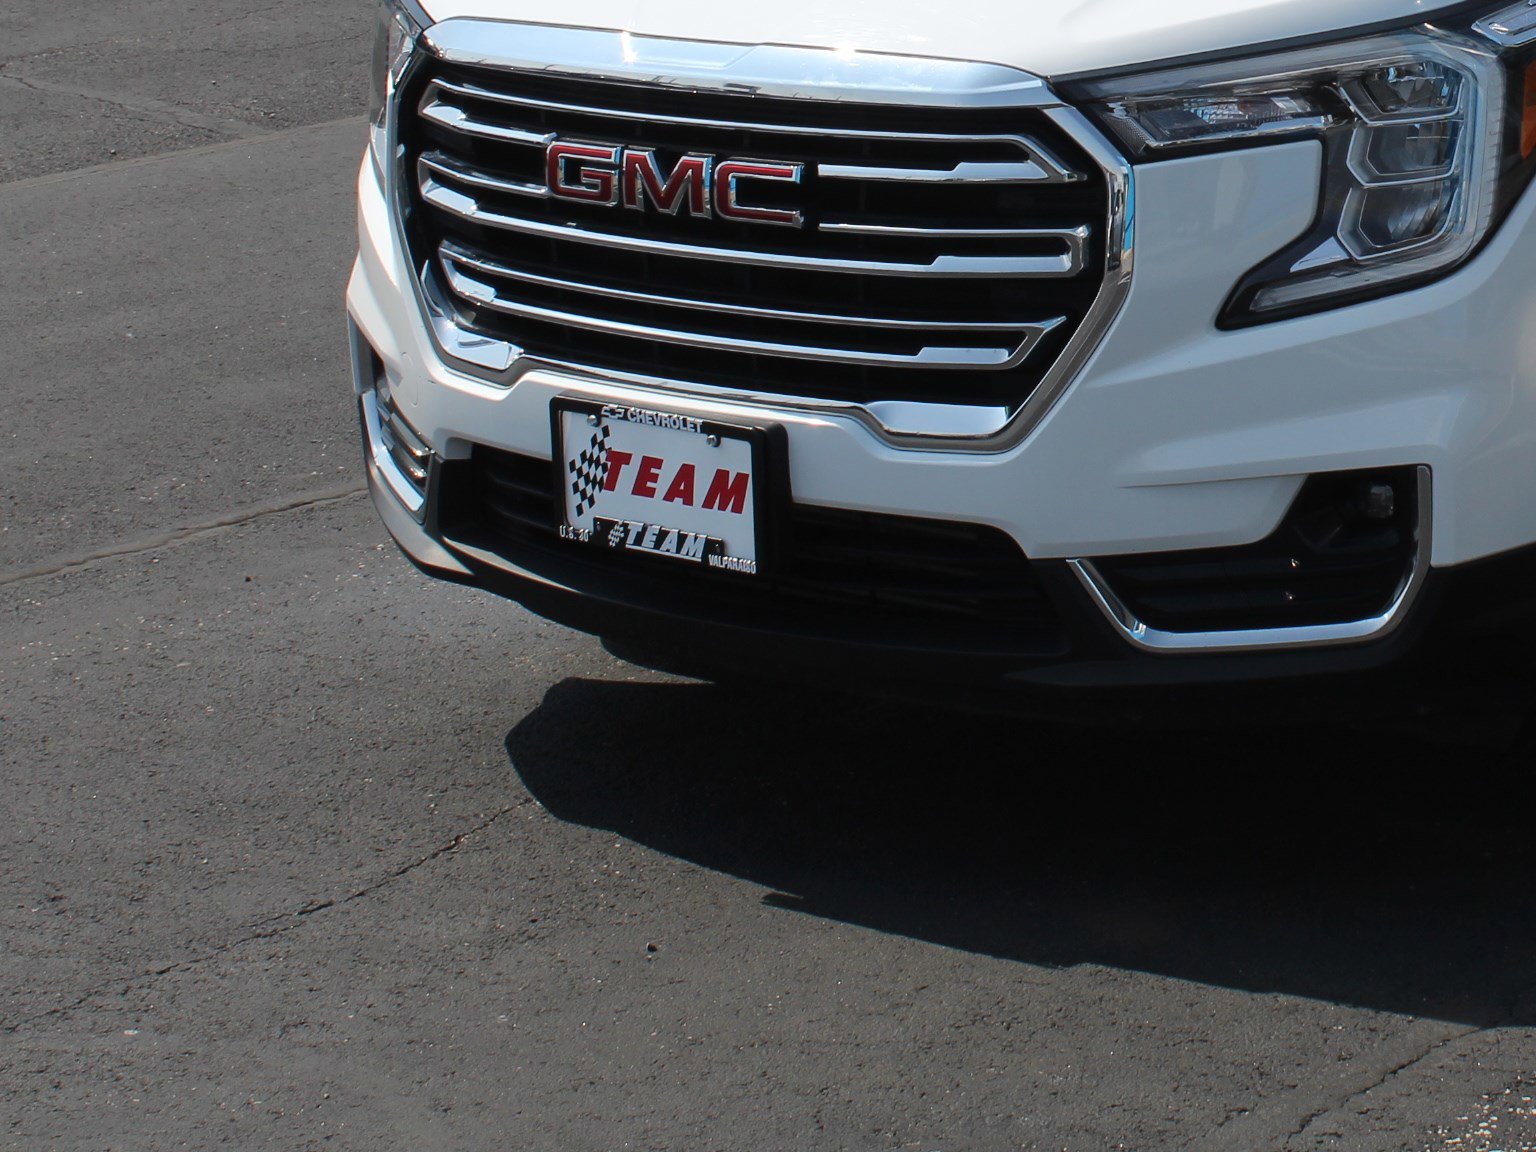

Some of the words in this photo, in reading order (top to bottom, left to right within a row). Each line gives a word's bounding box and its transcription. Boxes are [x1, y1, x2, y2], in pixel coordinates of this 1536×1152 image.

[546, 140, 804, 228] GMC
[627, 407, 704, 434] CHEVROLET
[603, 449, 750, 515] TEAM
[625, 520, 708, 559] TEAM
[708, 554, 757, 575] VALPARAISO
